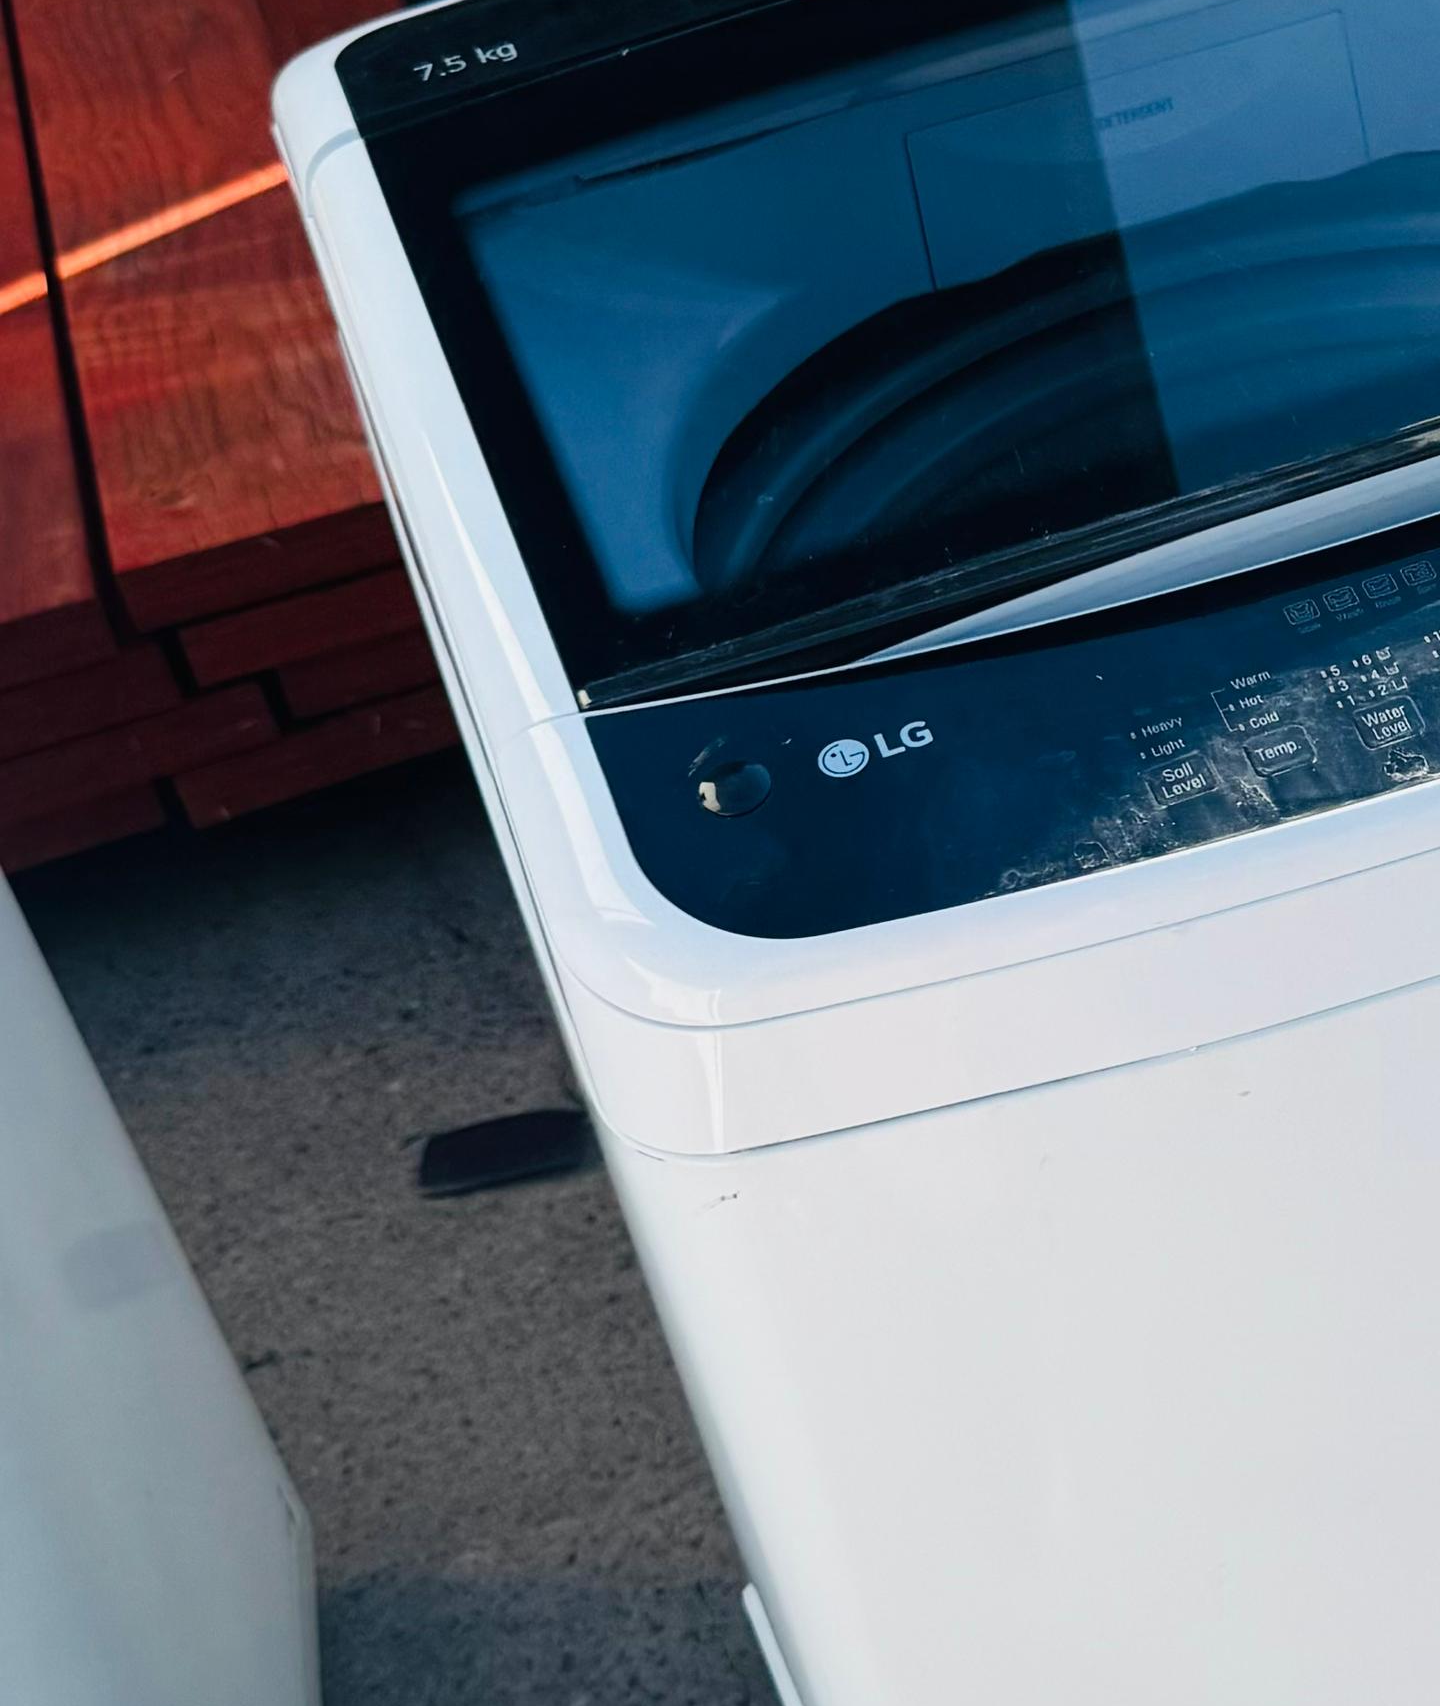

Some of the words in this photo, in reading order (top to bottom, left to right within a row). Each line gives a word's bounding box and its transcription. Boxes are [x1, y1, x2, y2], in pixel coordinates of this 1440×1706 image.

[413, 55, 467, 81] 7.5
[474, 43, 518, 63] kg
[1330, 664, 1341, 676] 5
[1361, 654, 1372, 666] 6
[1230, 671, 1271, 690] Warm
[1338, 680, 1349, 692] 3
[1371, 669, 1380, 680] 4
[1239, 694, 1264, 710] Hot
[1347, 694, 1357, 706] 1
[1378, 684, 1389, 696] 2
[1249, 711, 1280, 729] Cold
[1361, 704, 1406, 728] Water
[1141, 717, 1183, 738] Heavy
[1372, 716, 1413, 741] Level
[874, 721, 934, 758] LG
[1151, 739, 1187, 758] Light
[1254, 739, 1302, 762] Temp.
[1162, 761, 1194, 783] Soil
[1161, 774, 1207, 799] Level
